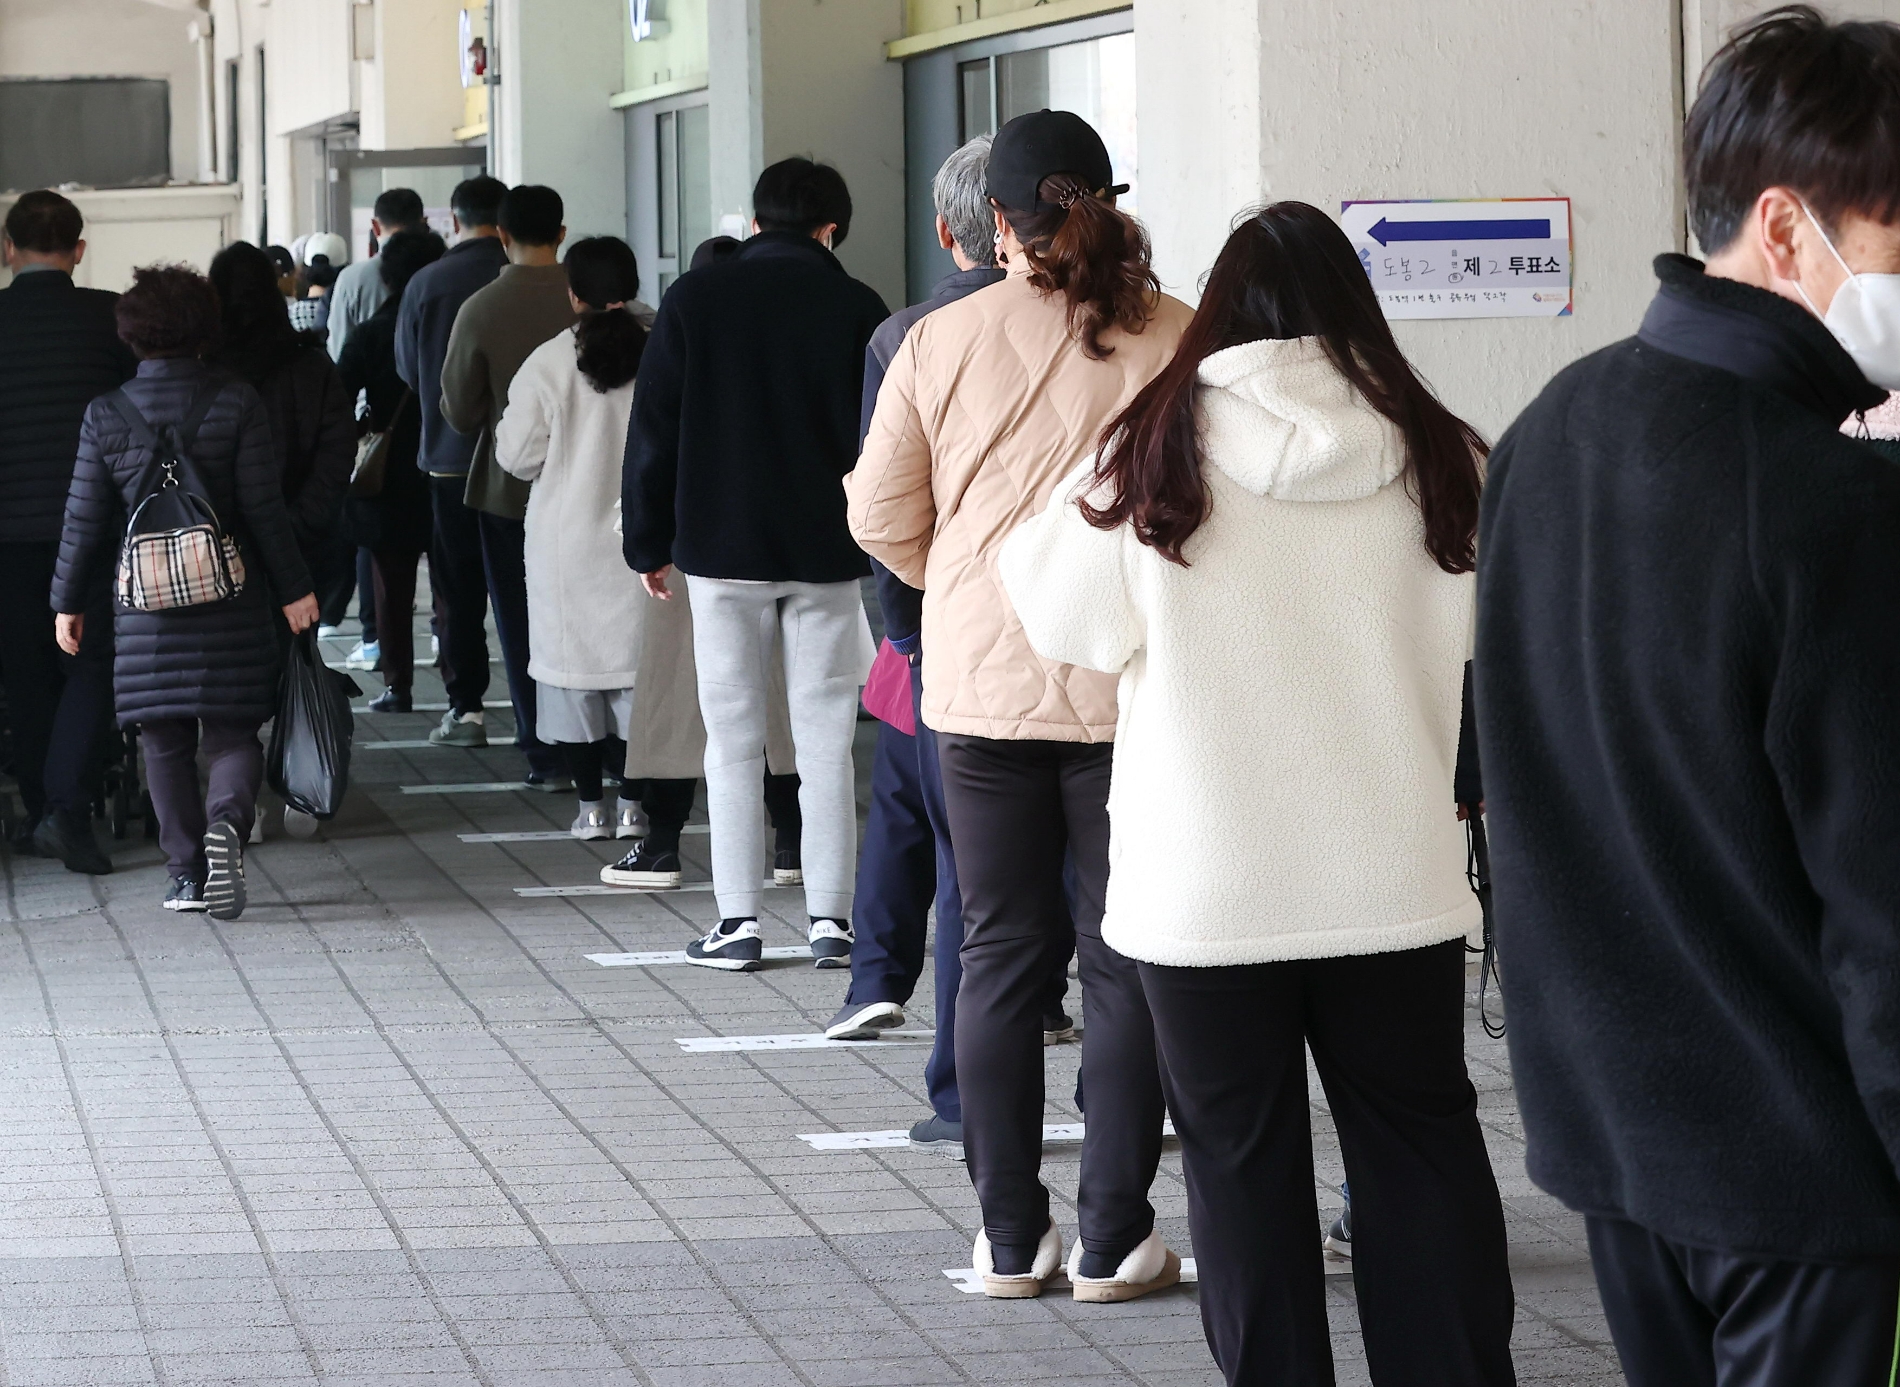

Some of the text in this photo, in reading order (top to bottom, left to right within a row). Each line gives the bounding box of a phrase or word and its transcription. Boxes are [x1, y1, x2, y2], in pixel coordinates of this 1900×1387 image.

[1463, 256, 1480, 276] 제
[1488, 260, 1502, 275] 2
[1508, 256, 1561, 276] 투표소
[816, 926, 832, 934] NIKE
